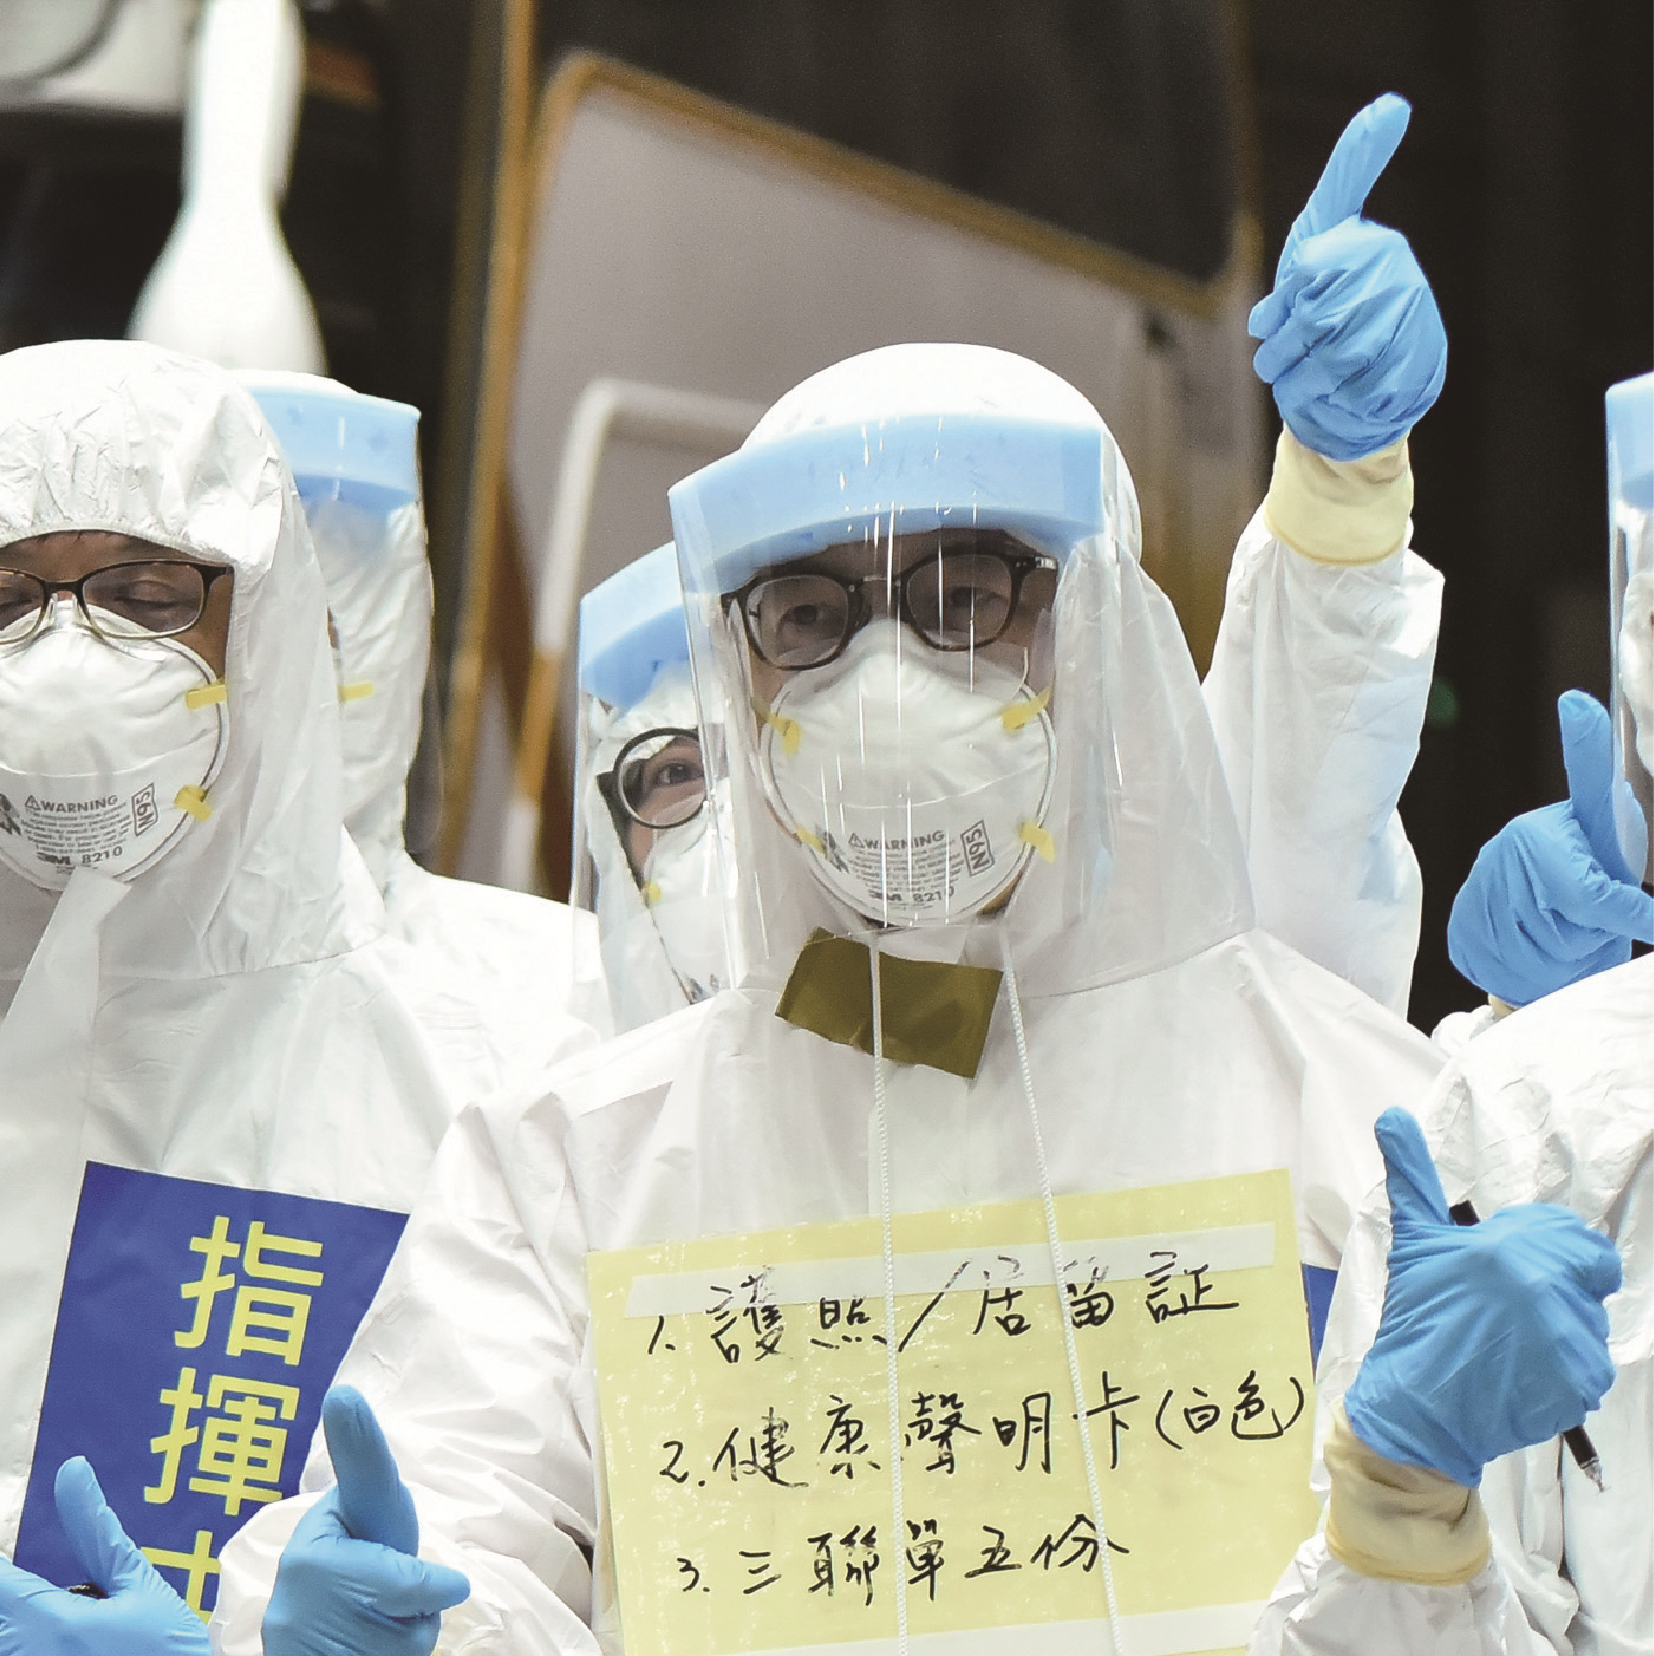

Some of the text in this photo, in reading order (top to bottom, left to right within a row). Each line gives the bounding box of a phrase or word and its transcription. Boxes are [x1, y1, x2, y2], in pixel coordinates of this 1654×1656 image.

[40, 794, 119, 813] WARNING
[81, 846, 123, 864] 8210
[965, 827, 991, 870] N95
